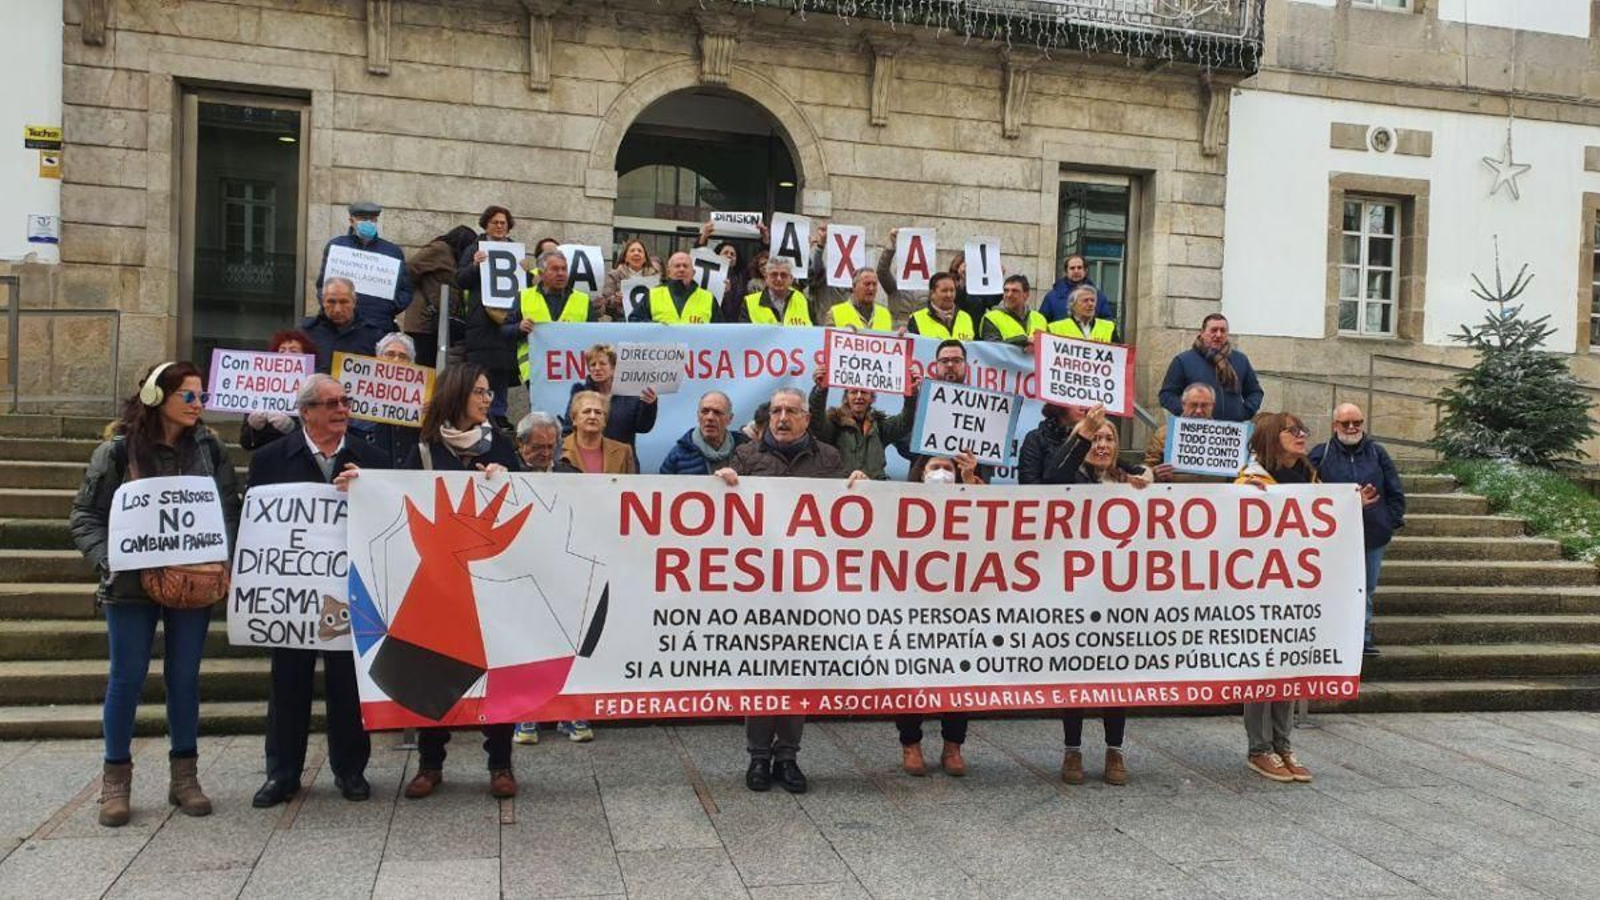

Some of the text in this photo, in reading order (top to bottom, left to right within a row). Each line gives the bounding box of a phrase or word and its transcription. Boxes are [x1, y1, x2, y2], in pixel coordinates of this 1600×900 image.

[777, 222, 803, 268] A
[834, 234, 858, 278] X
[902, 235, 929, 280] A
[979, 244, 989, 286] !
[488, 250, 518, 298] B
[568, 250, 597, 291] A
[694, 258, 721, 290] T
[620, 348, 685, 362] DIRECCION
[834, 336, 903, 355] FABIOLA
[1053, 341, 1114, 363] VAITE XA
[221, 355, 303, 373] Con RUEDA
[343, 357, 425, 385] Con RUEDA
[546, 350, 586, 380] EN
[744, 349, 806, 378] DOS
[839, 354, 883, 373] FÓRA
[1053, 356, 1112, 377] ARROYO
[222, 375, 300, 393] e FABIOLA
[620, 371, 678, 383] DIMISION
[867, 372, 893, 389] FÓRA
[1050, 368, 1115, 391] TI ERES O
[215, 393, 248, 409] TODO
[344, 379, 422, 405] e FABIOLA
[932, 387, 1009, 414] A XUNTA
[1050, 383, 1114, 405] ESCOLLO
[382, 406, 419, 422] TROLA
[952, 413, 985, 433] TEN
[1179, 433, 1241, 448] TODO CONTO
[1181, 421, 1241, 437] INSPECCIÓN:
[925, 434, 937, 449] A
[945, 435, 1001, 459] CULPA
[1178, 444, 1239, 458] TODO CONTO
[1177, 454, 1238, 468] TODO CONTO
[122, 489, 214, 511] LOS SENSORES
[159, 508, 195, 534] NO
[619, 491, 1337, 541] NON AO DETERIORO DAS
[120, 533, 179, 554] CAMBIAN
[290, 529, 307, 550] E
[655, 540, 1322, 593] RESIDENCIAS PÚBLICAS
[234, 587, 320, 615] MESMA
[653, 603, 1322, 626] NON AO ABANDONO DAS PERSOAS MAIORES NON AOS MALOS TRATOS
[248, 618, 315, 645] SON!
[659, 627, 1316, 652] SI Á TRANSPARENCIA E Á EMPATÍA SI AOS CONSELLOS DE RESIDENCIAS
[624, 646, 1343, 679] SI A UNHA ALIMENTACIÓN DIGNA OUTRO MODELO DAS PÚBLICAS É POSÍBEL
[595, 680, 1354, 715] FEDERACIÓN REDE + ASOCIACIÓN USUARIAS E FAMILIARES DO CRAPO DE VIGO
